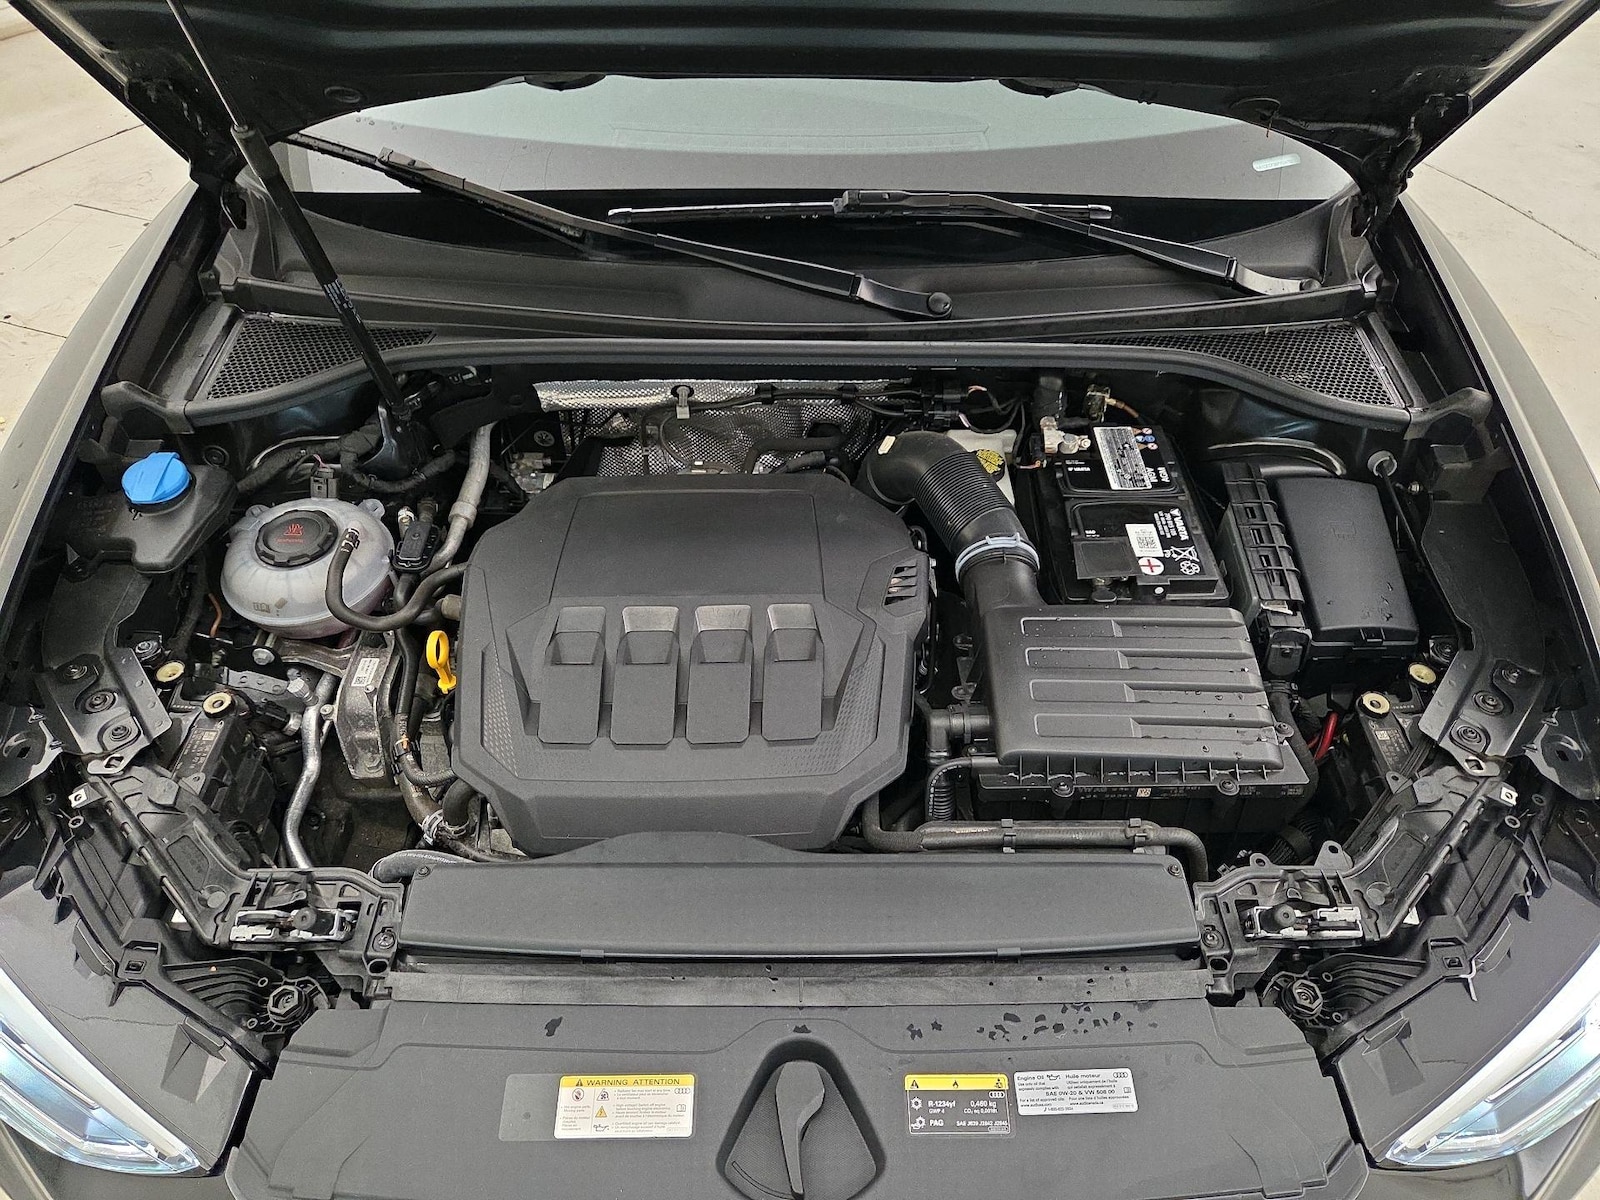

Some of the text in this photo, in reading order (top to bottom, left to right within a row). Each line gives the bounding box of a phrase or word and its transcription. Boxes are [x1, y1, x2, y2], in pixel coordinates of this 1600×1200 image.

[1174, 516, 1190, 540] VARTA
[928, 1100, 956, 1108] R-1234yf
[988, 1100, 996, 1108] kg
